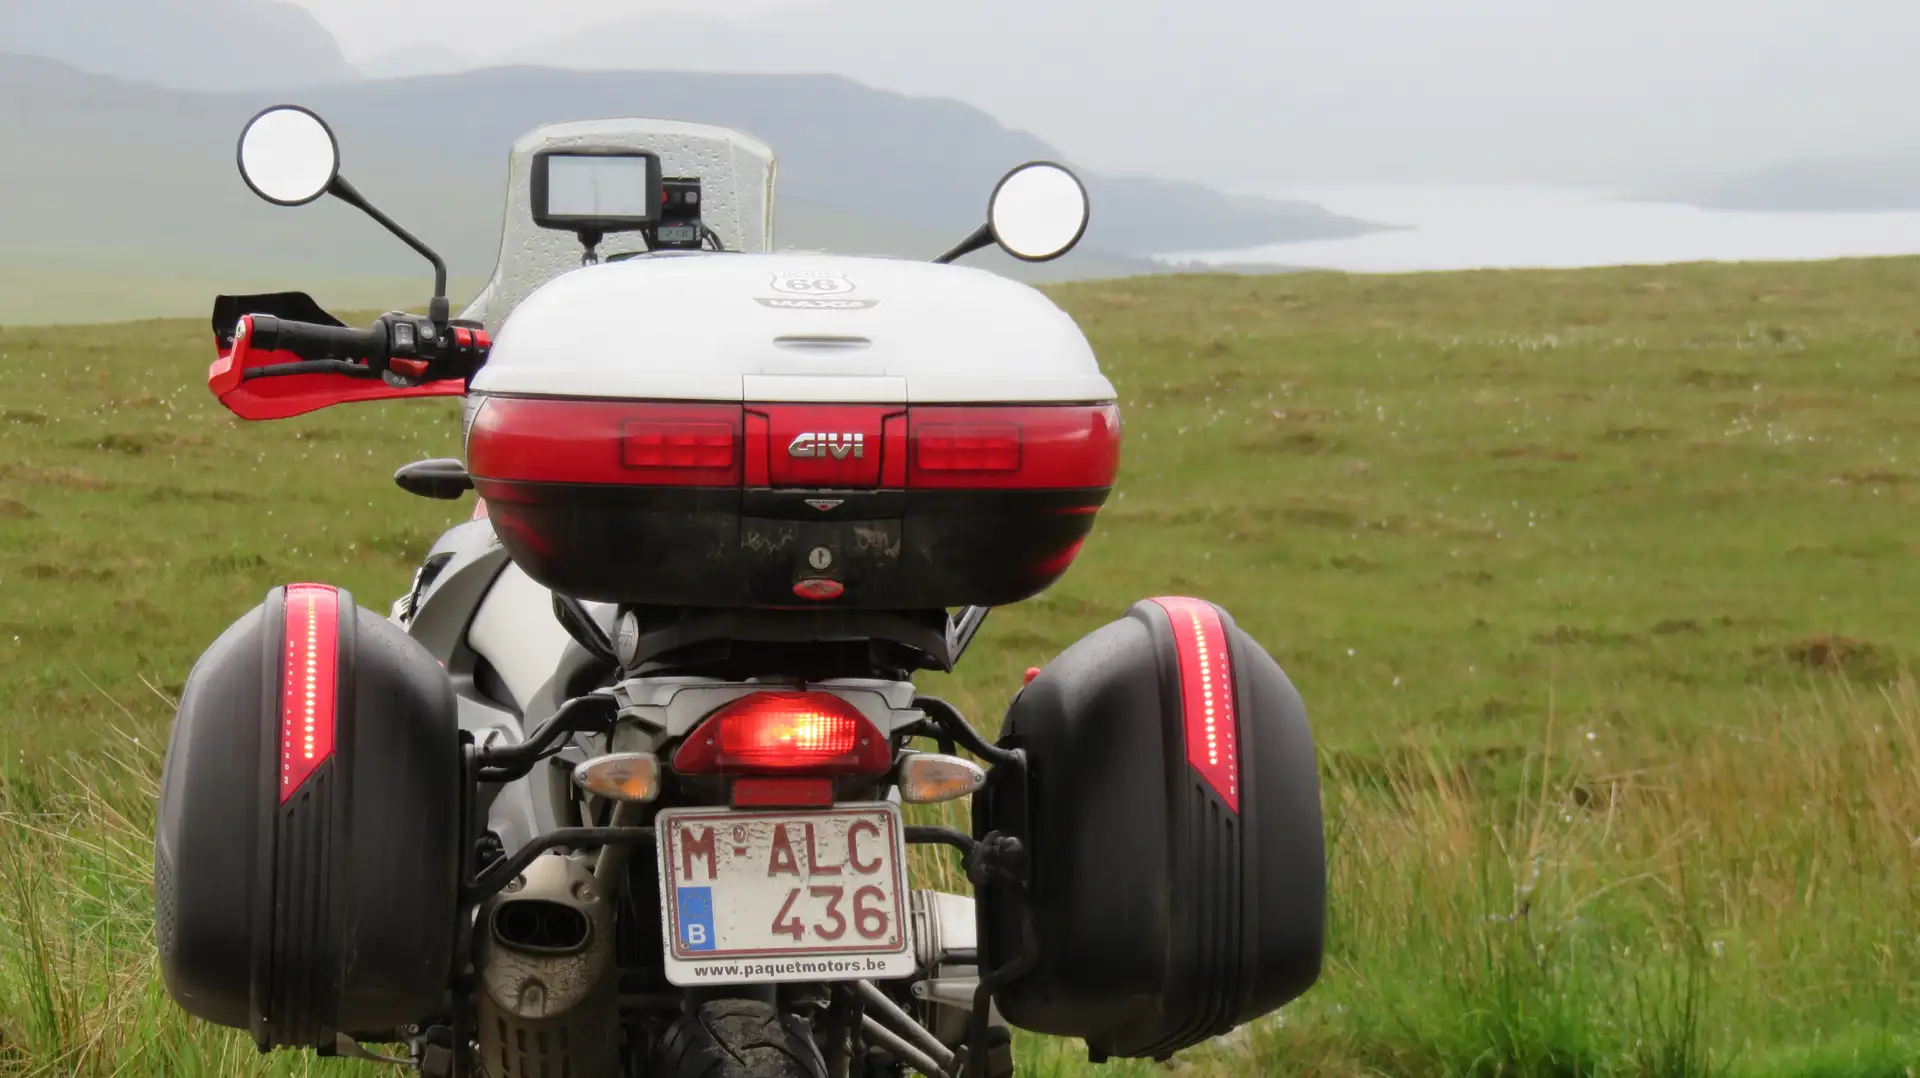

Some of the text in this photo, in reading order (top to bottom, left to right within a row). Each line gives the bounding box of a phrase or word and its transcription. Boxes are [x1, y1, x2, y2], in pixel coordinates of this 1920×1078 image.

[786, 279, 839, 291] 66
[788, 433, 864, 460] GIVI
[284, 708, 293, 785] MONOKEY
[771, 885, 889, 941] 436
[688, 924, 707, 944] B
[694, 958, 887, 977] www.paquetmotors.be
